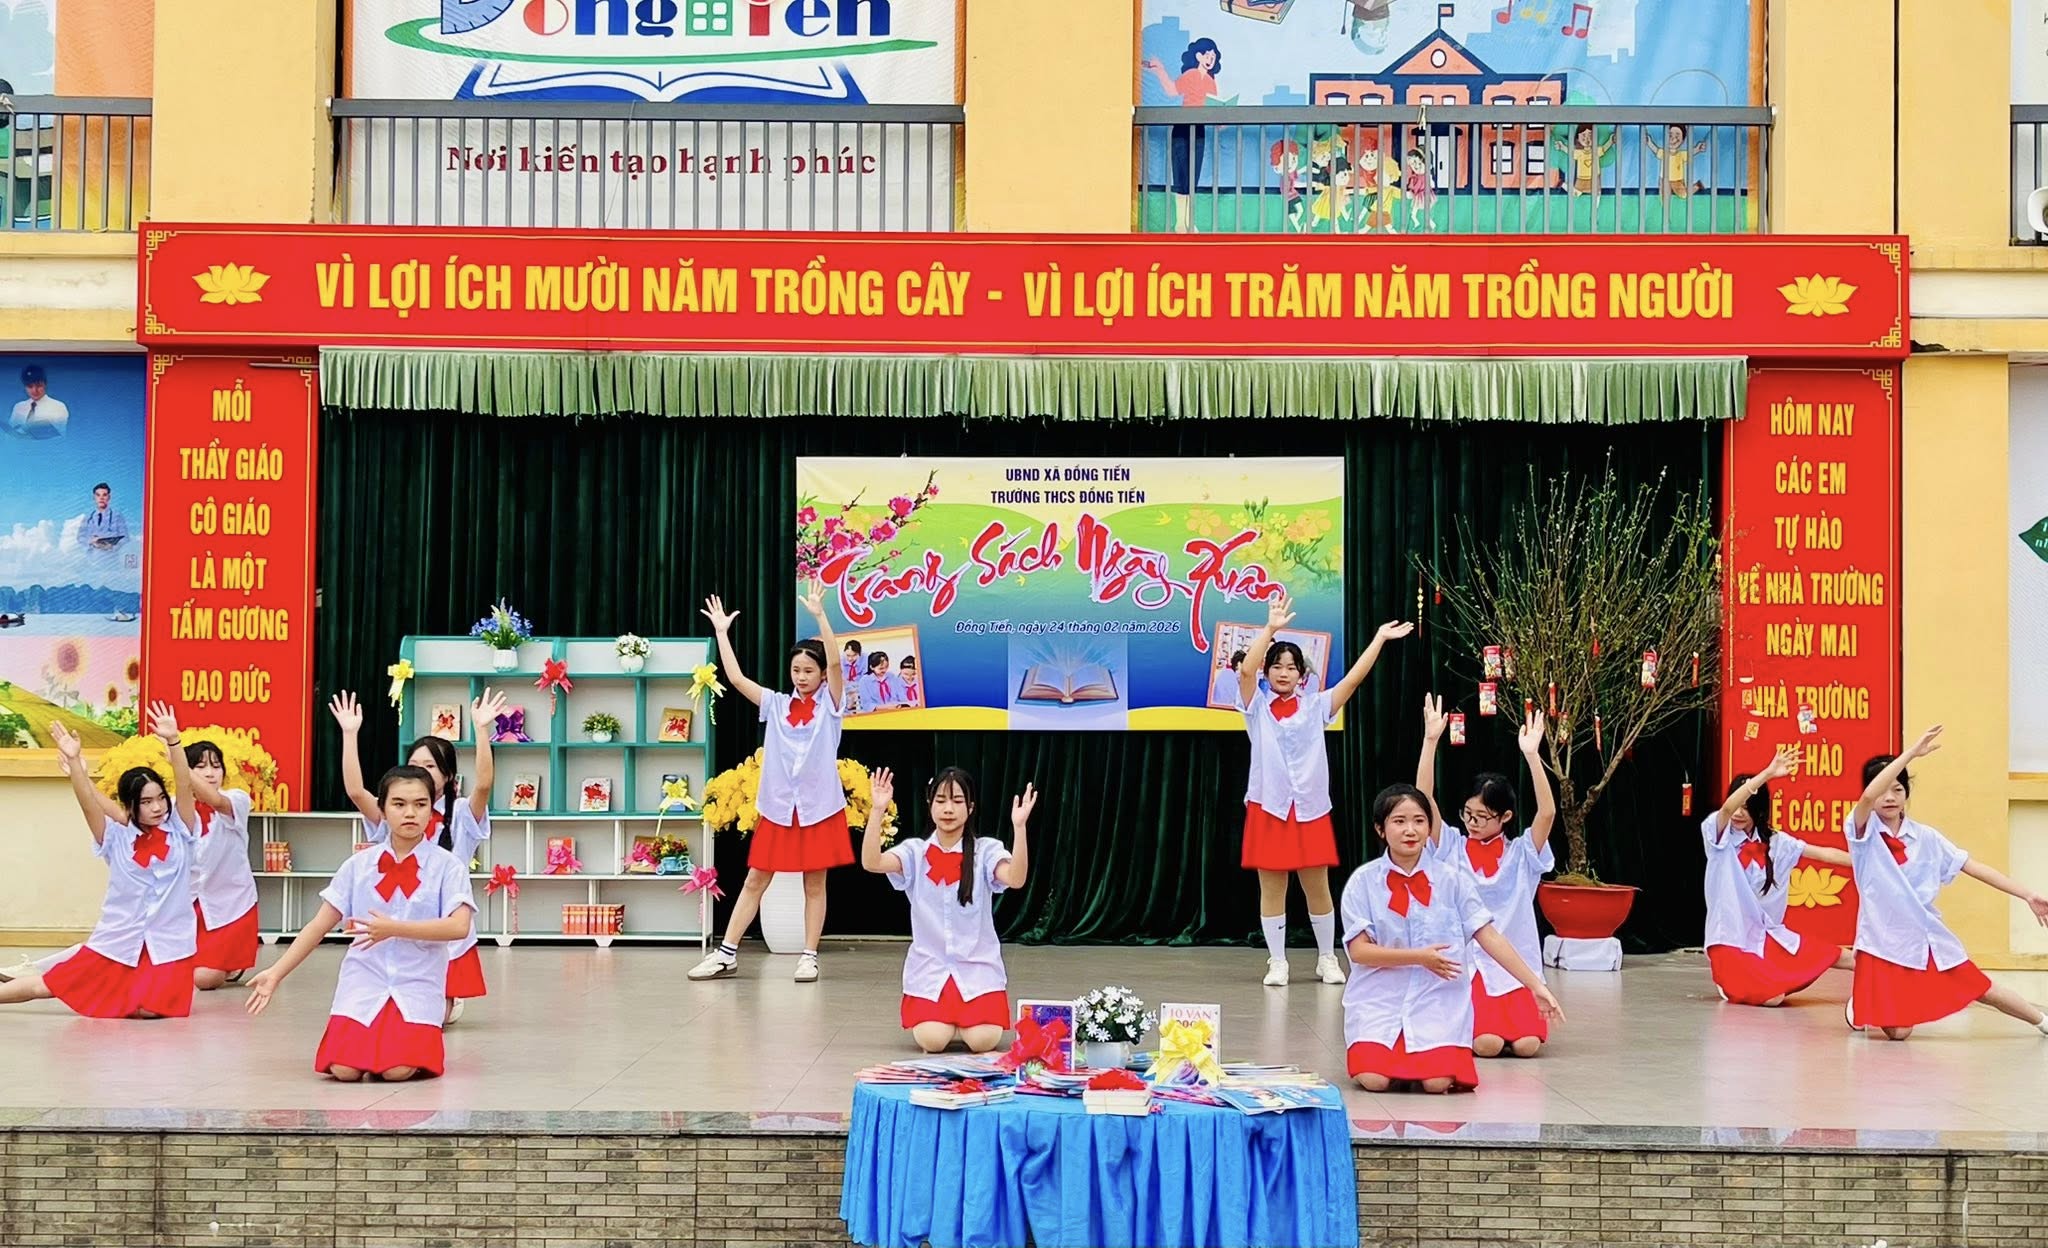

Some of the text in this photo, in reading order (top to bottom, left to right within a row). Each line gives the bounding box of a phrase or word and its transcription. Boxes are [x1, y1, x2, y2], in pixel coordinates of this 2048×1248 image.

[447, 143, 876, 181] Nơi kiến tạo hạnh phúc
[316, 253, 1732, 326] VÌ LỢI ÍCH MƯỜI NĂM TRỒNG CÂY - VÌ LỢI ÍCH TRĂM NĂM TRỒNG NGƯỜI
[212, 378, 252, 422] MỖI
[1770, 396, 1855, 436] HÔM NAY
[179, 437, 284, 481] THẦY GIÁO
[1005, 468, 1040, 482] UBND
[1044, 465, 1061, 482] XÃ
[1102, 464, 1130, 481] TIẾN
[1775, 455, 1846, 494] CÁC EM
[190, 496, 271, 536] CÔ GIÁO
[990, 487, 1040, 504] TRƯỜNG
[1044, 490, 1076, 503] THCS
[1117, 487, 1145, 503] TIẾN
[1774, 510, 1843, 556] TỰ HÀO
[190, 550, 268, 596] LÀ MỘT
[818, 546, 970, 627] Trang
[970, 522, 1063, 587] Sách
[1075, 513, 1194, 610] Ngày
[1183, 529, 1286, 653] Xuân
[1737, 562, 1884, 606] VỀ NHÀ TRƯỜNG
[169, 598, 289, 641] TẤM GƯƠNG
[1017, 619, 1047, 635] ngày
[1049, 621, 1065, 633] 24
[1067, 619, 1100, 634] tháng
[1103, 621, 1119, 633] 02
[1121, 621, 1147, 633] năm
[1149, 621, 1181, 633] 2026
[1766, 617, 1857, 658] NGÀY MAI
[181, 663, 271, 708] ĐẠO ĐỨC
[1753, 679, 1789, 718] NHÀ
[1795, 680, 1869, 720] TRƯỜNG
[1805, 737, 1843, 777] HÀO
[1771, 789, 1783, 832] Ề
[1788, 792, 1826, 832] CÁC
[1169, 1007, 1183, 1019] 10
